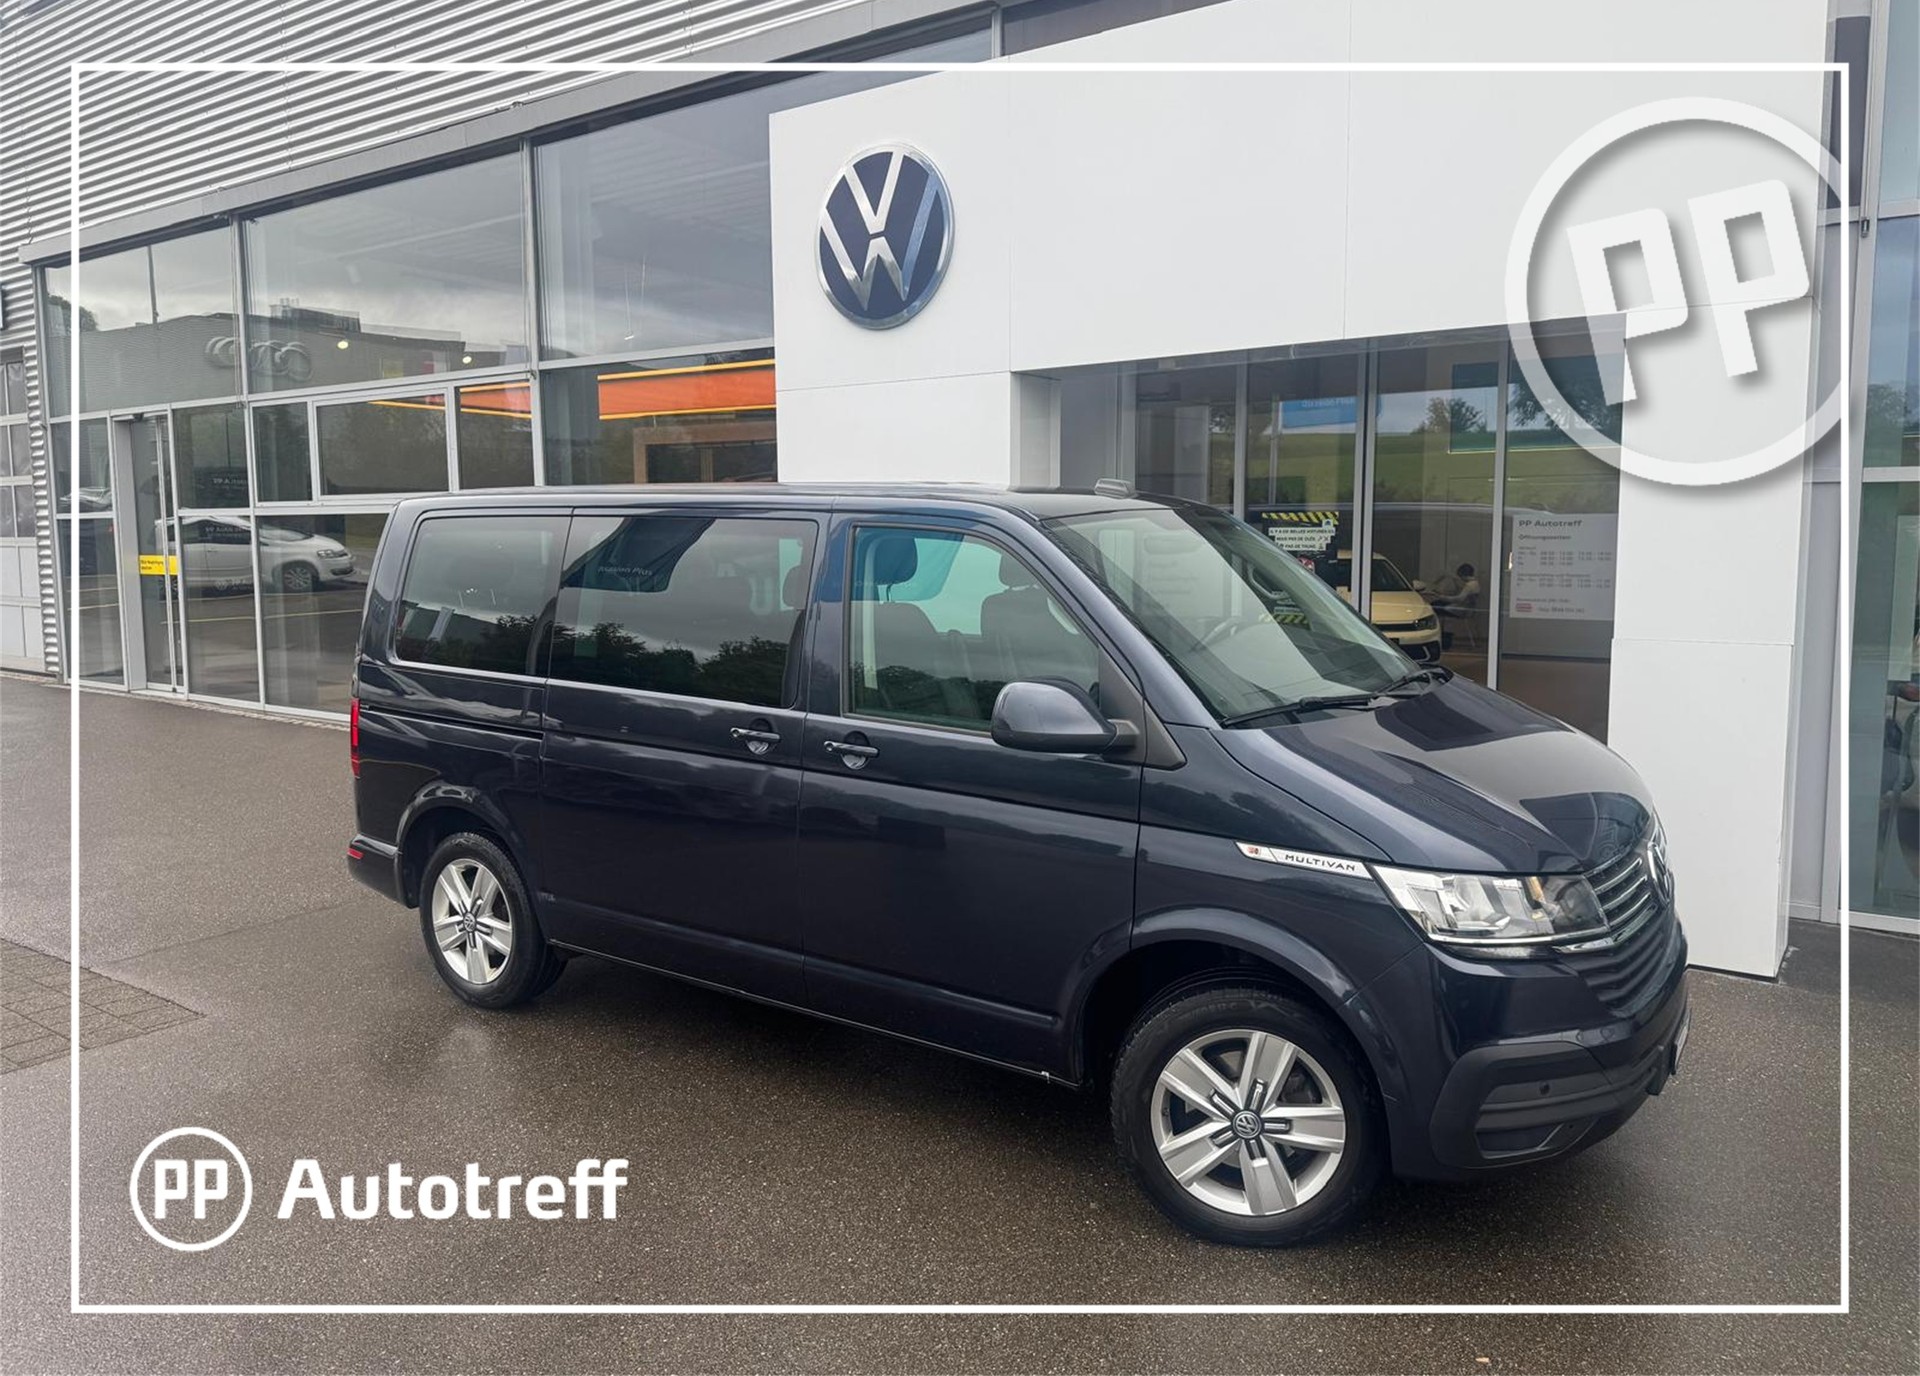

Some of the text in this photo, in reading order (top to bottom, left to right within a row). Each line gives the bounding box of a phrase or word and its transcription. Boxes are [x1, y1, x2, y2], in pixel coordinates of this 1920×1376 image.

[1518, 519, 1583, 528] PP Autotreff
[1285, 853, 1356, 872] MULTIVAN
